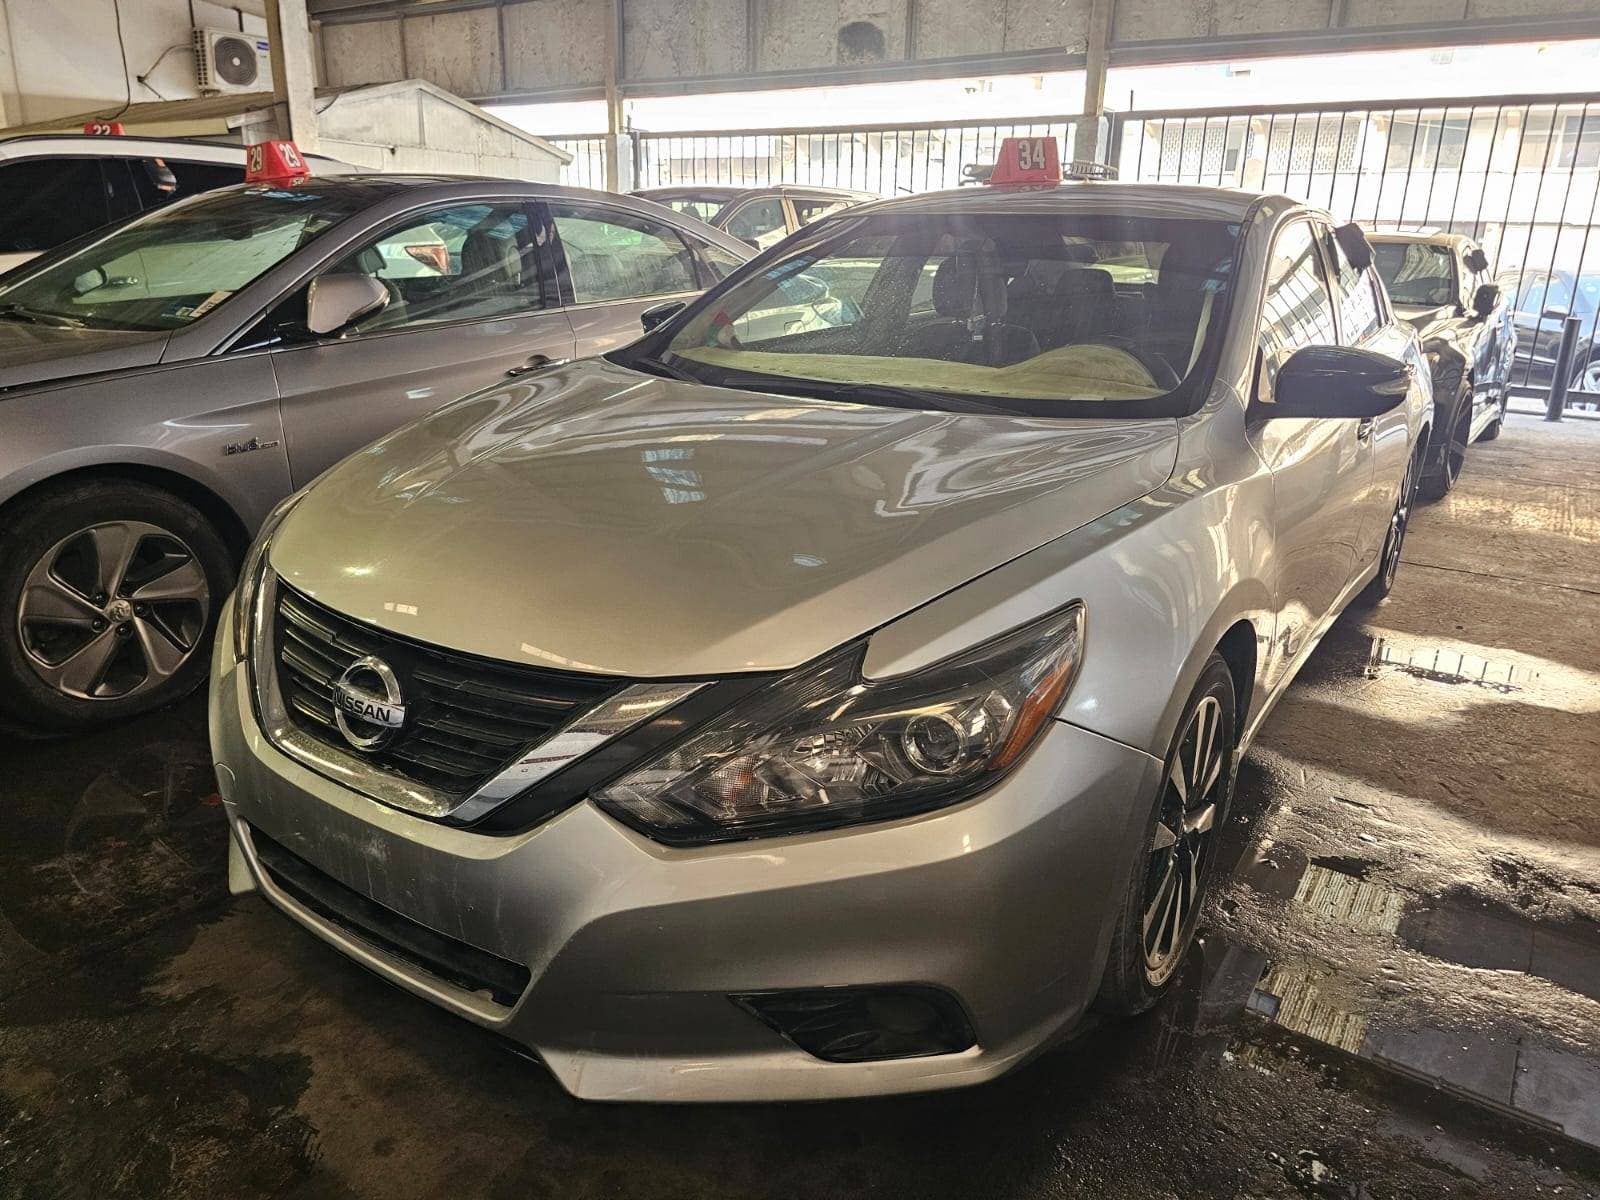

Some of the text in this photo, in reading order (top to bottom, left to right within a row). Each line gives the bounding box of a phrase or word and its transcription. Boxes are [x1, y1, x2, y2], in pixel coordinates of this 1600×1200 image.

[251, 145, 262, 172] 29
[279, 143, 301, 167] 29
[1018, 139, 1046, 170] 34
[335, 686, 391, 722] NISSAN
